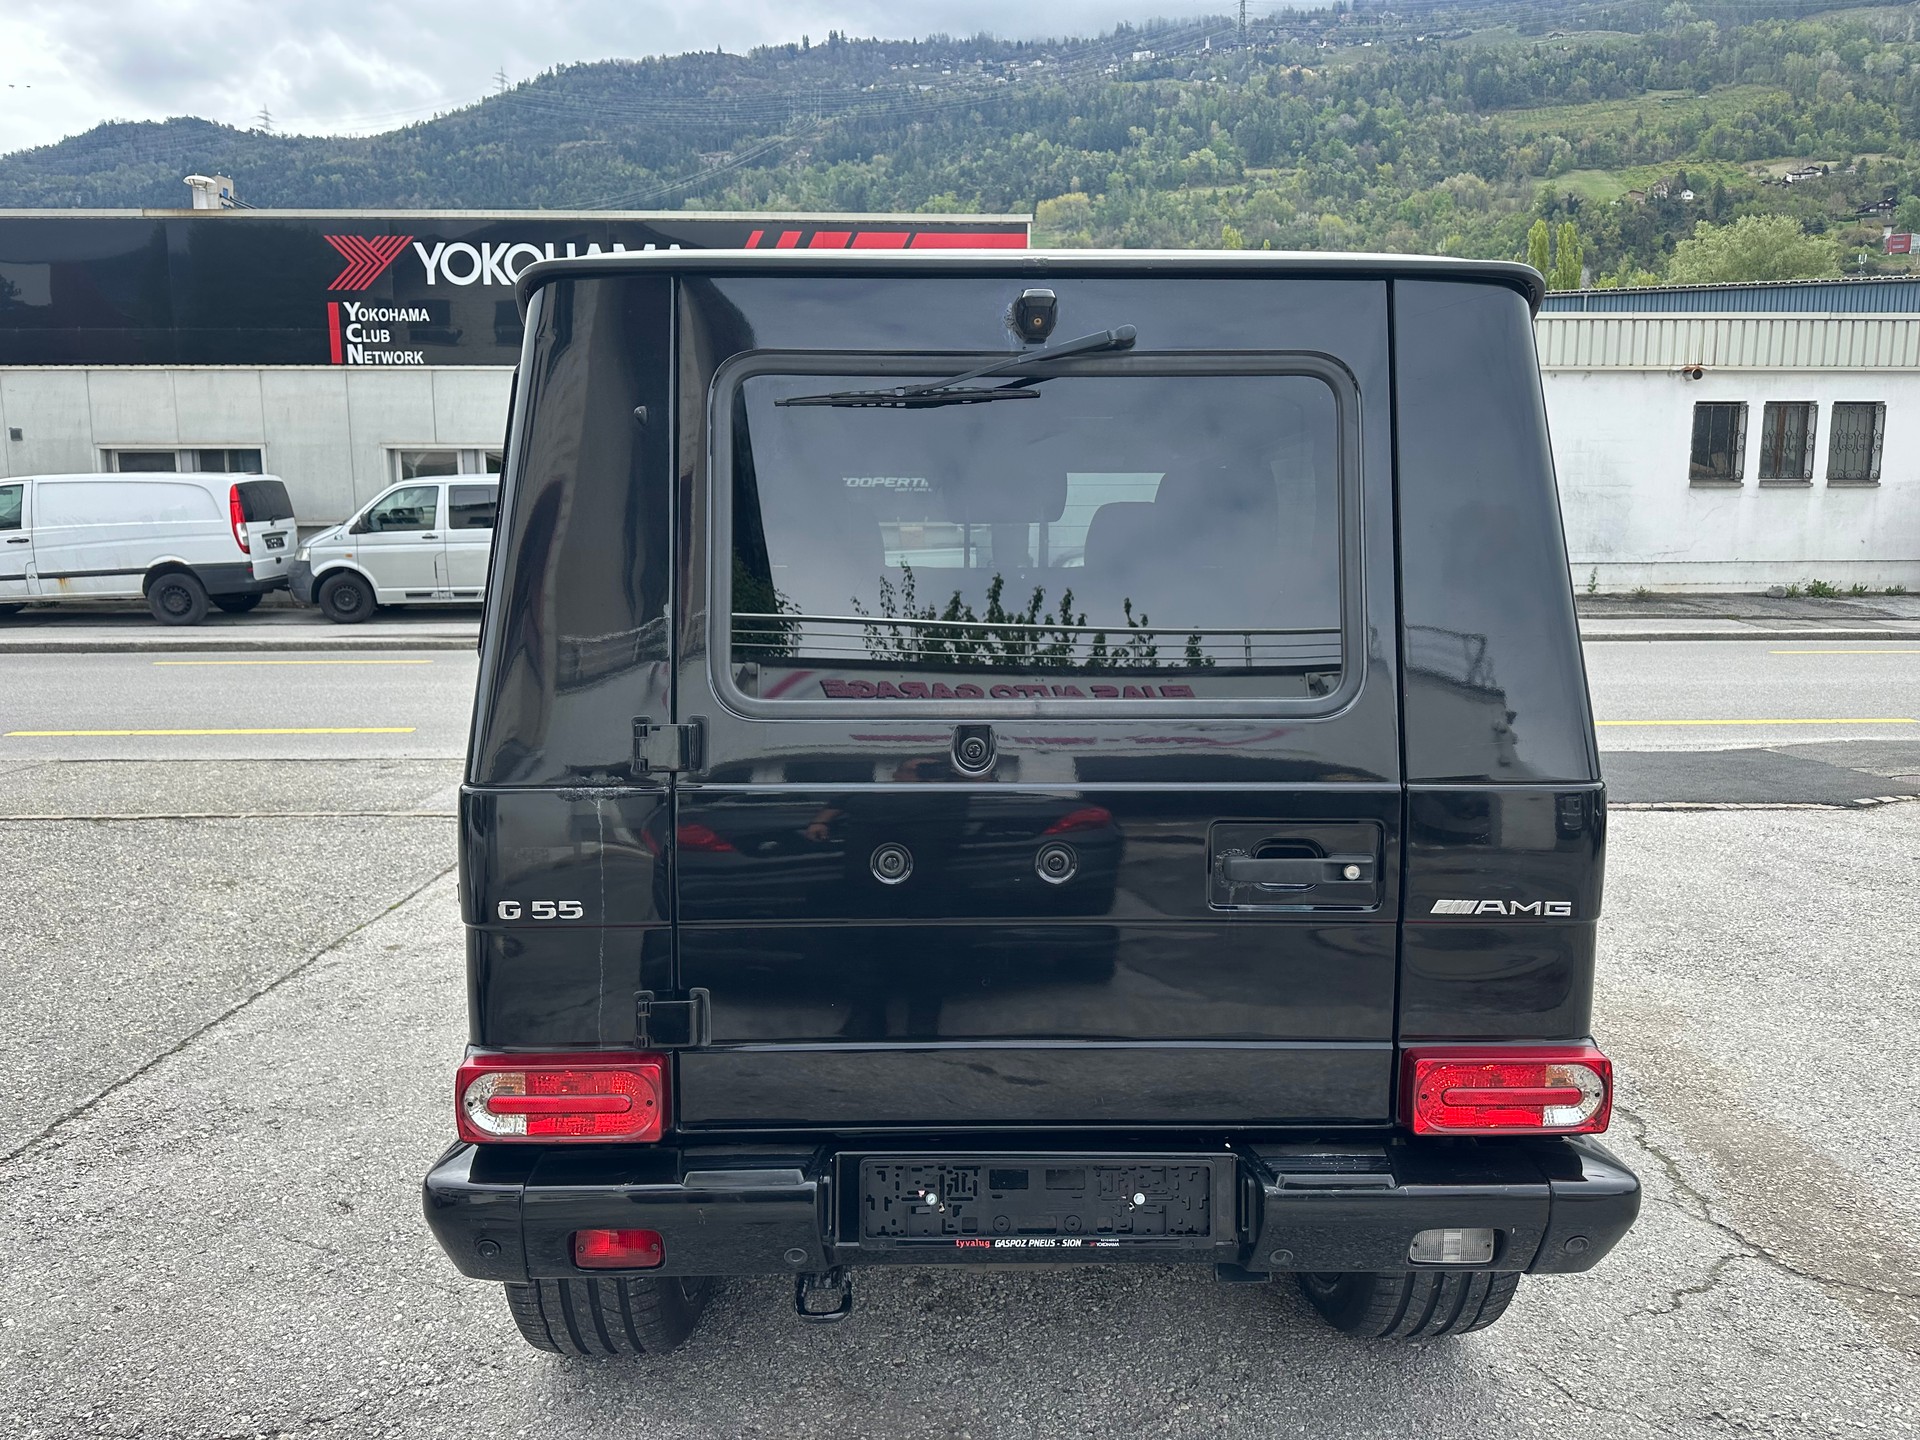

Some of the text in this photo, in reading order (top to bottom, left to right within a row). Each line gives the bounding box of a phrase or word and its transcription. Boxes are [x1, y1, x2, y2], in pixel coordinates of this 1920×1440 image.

[413, 242, 683, 286] YOKO
[343, 302, 430, 321] YOKOHAMA
[346, 324, 391, 342] CLUB
[347, 344, 424, 364] NETWORK
[498, 901, 583, 919] G 55
[1474, 900, 1572, 916] AMG
[956, 1239, 990, 1248] tyvalug
[994, 1239, 1027, 1248] GASPOZ
[1028, 1239, 1056, 1247] PNEUS
[1061, 1239, 1082, 1247] SION
